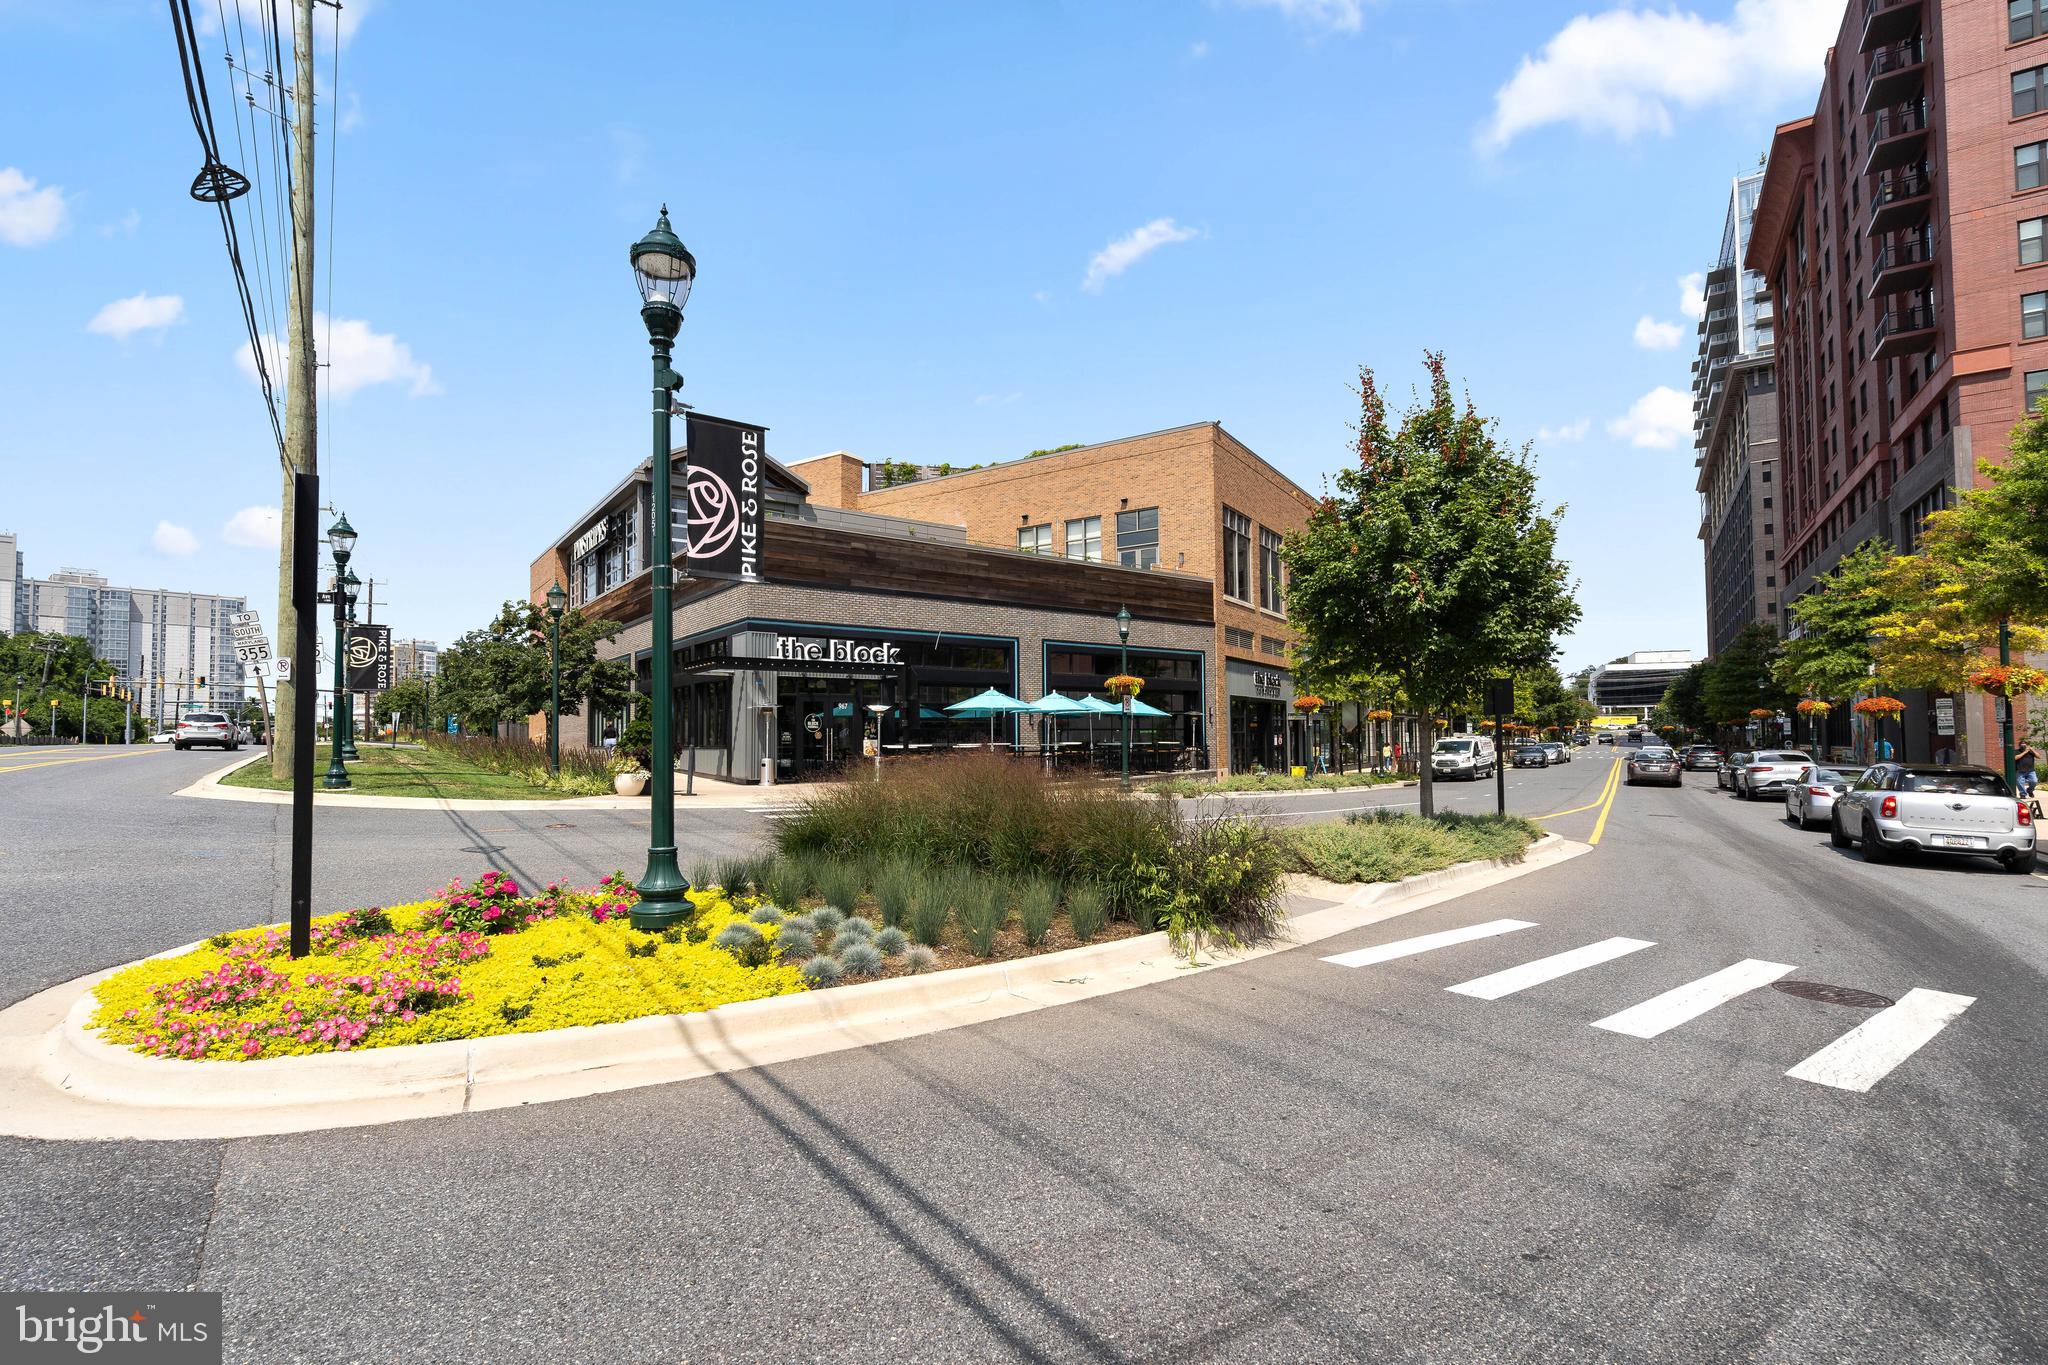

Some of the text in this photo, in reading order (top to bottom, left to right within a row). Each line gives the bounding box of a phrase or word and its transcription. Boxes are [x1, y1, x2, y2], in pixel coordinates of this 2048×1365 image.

[741, 431, 758, 577] PIKE & ROSE
[237, 613, 251, 621] TO
[234, 626, 260, 637] SOUTH
[378, 629, 388, 653] PIKE
[239, 646, 268, 661] 355
[777, 637, 900, 664] the block
[377, 664, 387, 689] ROSE
